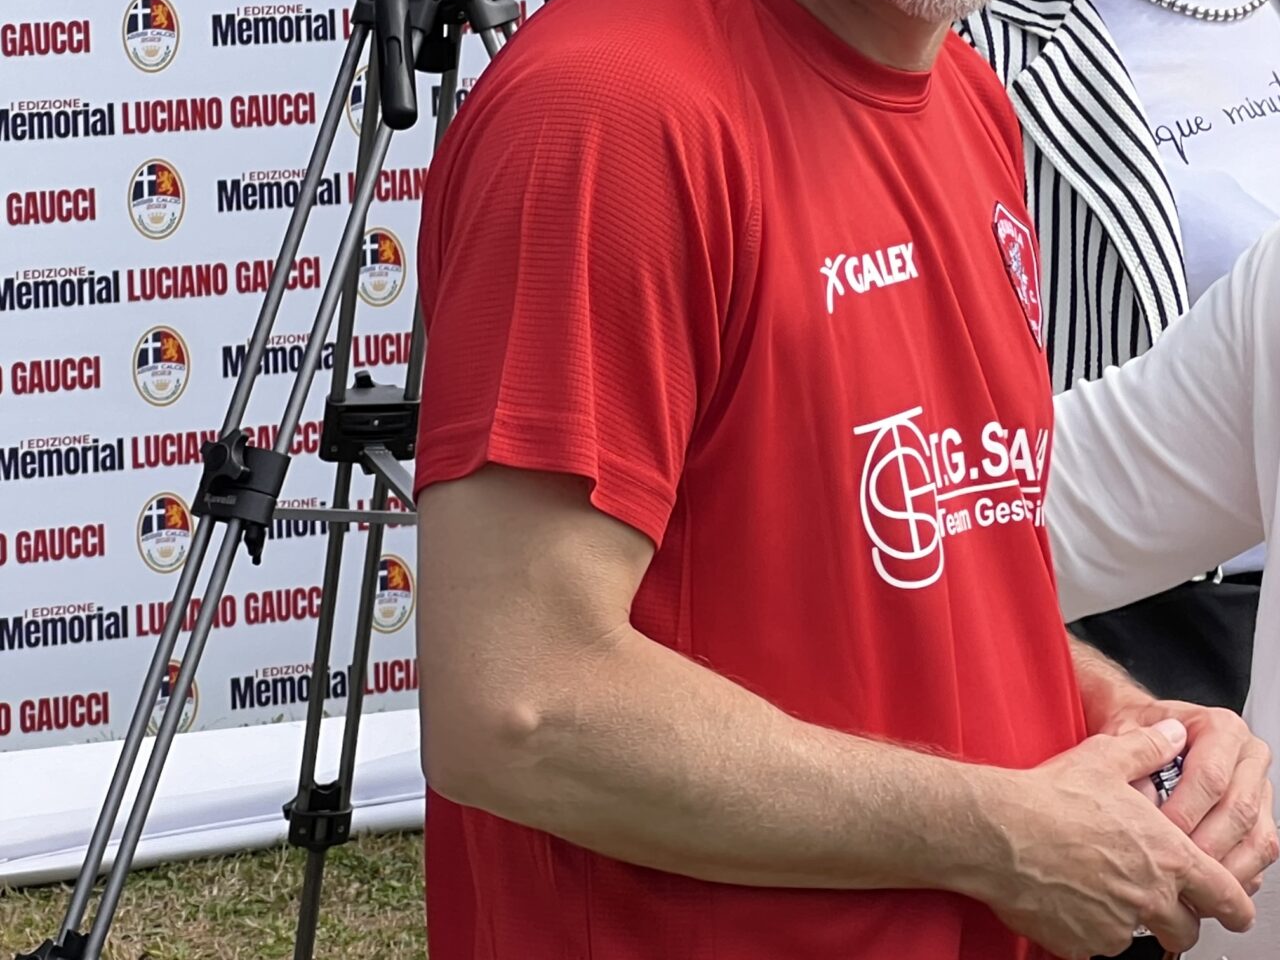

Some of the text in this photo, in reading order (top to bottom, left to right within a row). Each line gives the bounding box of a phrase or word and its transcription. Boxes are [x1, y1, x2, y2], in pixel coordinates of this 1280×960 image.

[212, 9, 336, 47] Memorial
[244, 4, 303, 16] EDIZIONE
[1, 20, 91, 58] GAUCCI
[18, 98, 81, 111] EDIZIONE
[121, 97, 223, 135] LUCIANO
[230, 92, 316, 128] GAUCCI
[1155, 114, 1212, 165] que
[6, 188, 96, 226] GAUCCI
[217, 172, 341, 213] Memoal
[0, 270, 120, 311] Memorial
[127, 262, 229, 302] LUCIANO
[23, 266, 86, 280] EDIZIONE
[845, 242, 919, 294] GALEX
[12, 356, 101, 395] GAUCCI
[0, 437, 125, 481] Memorial
[28, 434, 90, 449] EDIZIONE
[15, 524, 106, 565] GAUCCI
[0, 606, 129, 652] Memorial
[244, 586, 323, 625] GAUCC
[32, 602, 95, 618] EDIZIONE
[262, 663, 314, 678] EDIZION
[20, 692, 109, 733] GAUCCI
